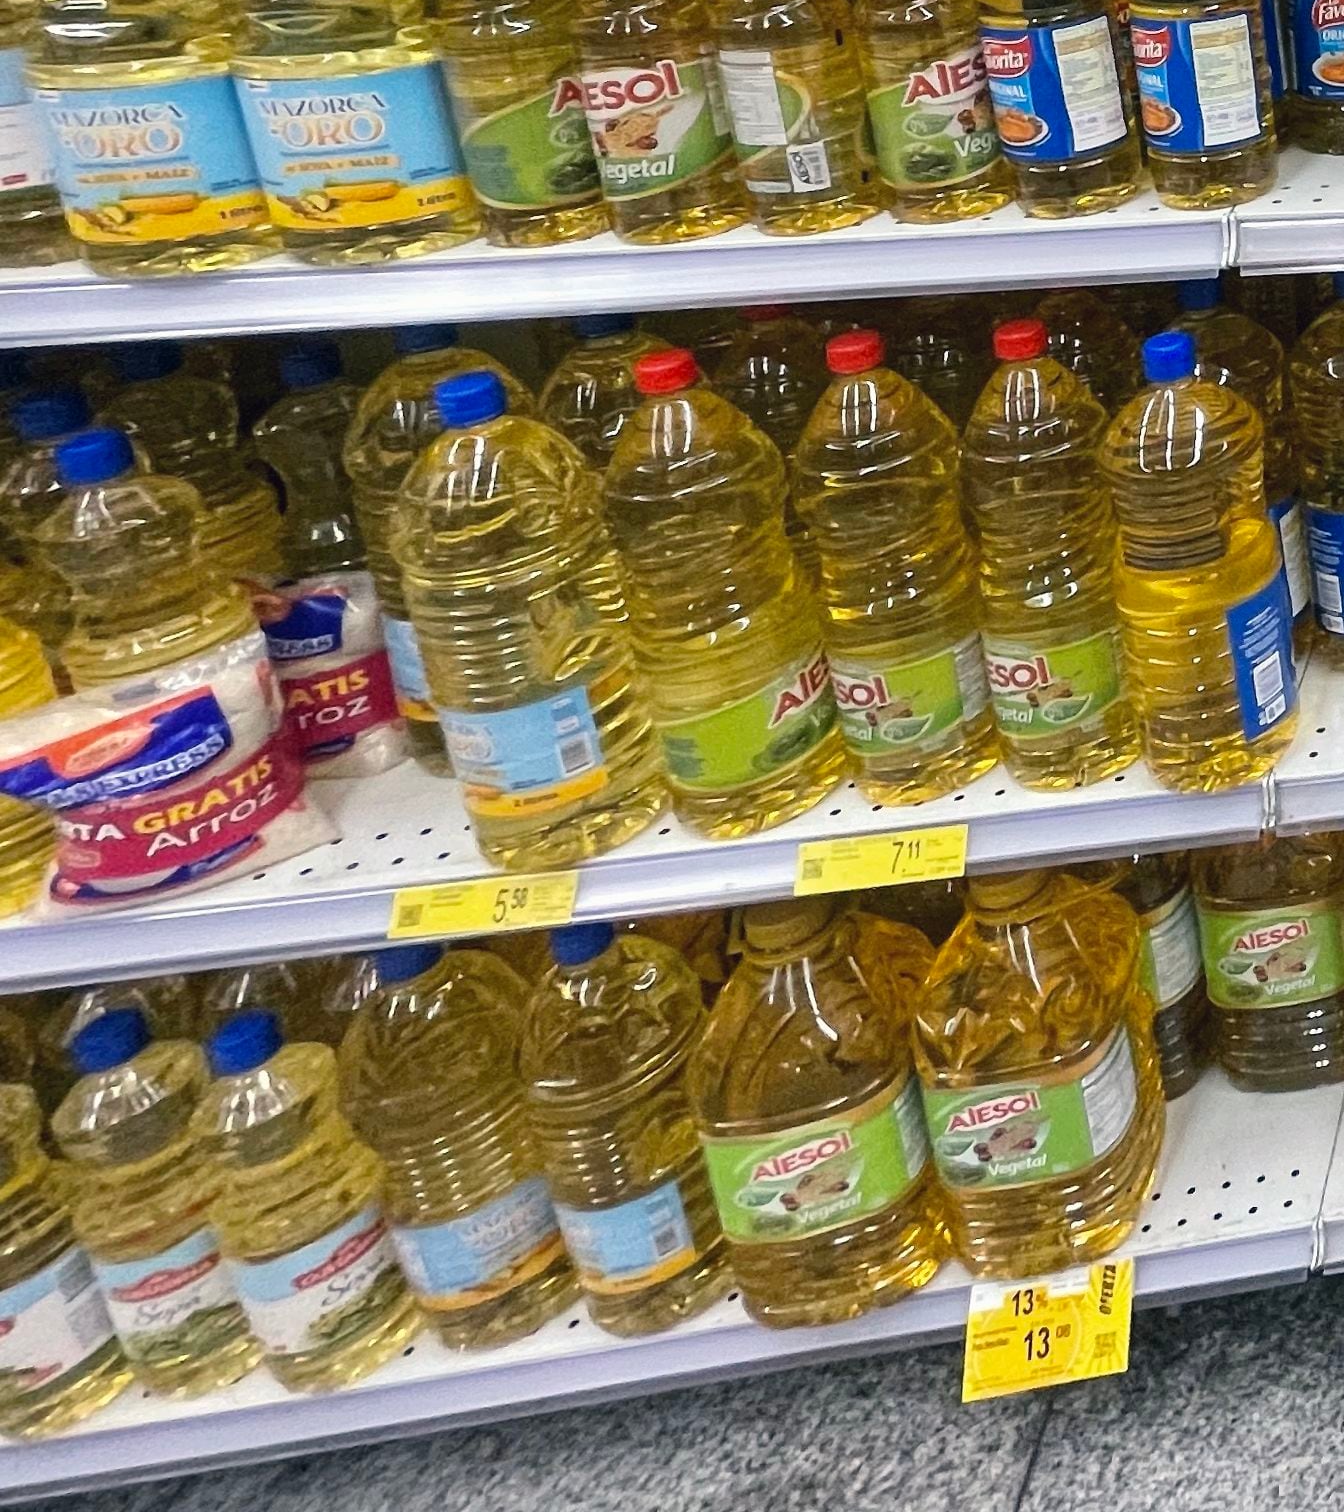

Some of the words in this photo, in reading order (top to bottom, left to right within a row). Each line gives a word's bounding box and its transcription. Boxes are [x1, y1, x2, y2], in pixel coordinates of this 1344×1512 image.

[73, 126, 182, 159] ORO
[282, 112, 385, 148] ORO
[133, 754, 273, 834] GRATIS
[1263, 975, 1317, 995] Vegetal
[987, 1153, 1049, 1177] Vegetal
[799, 1195, 863, 1224] Vegetal
